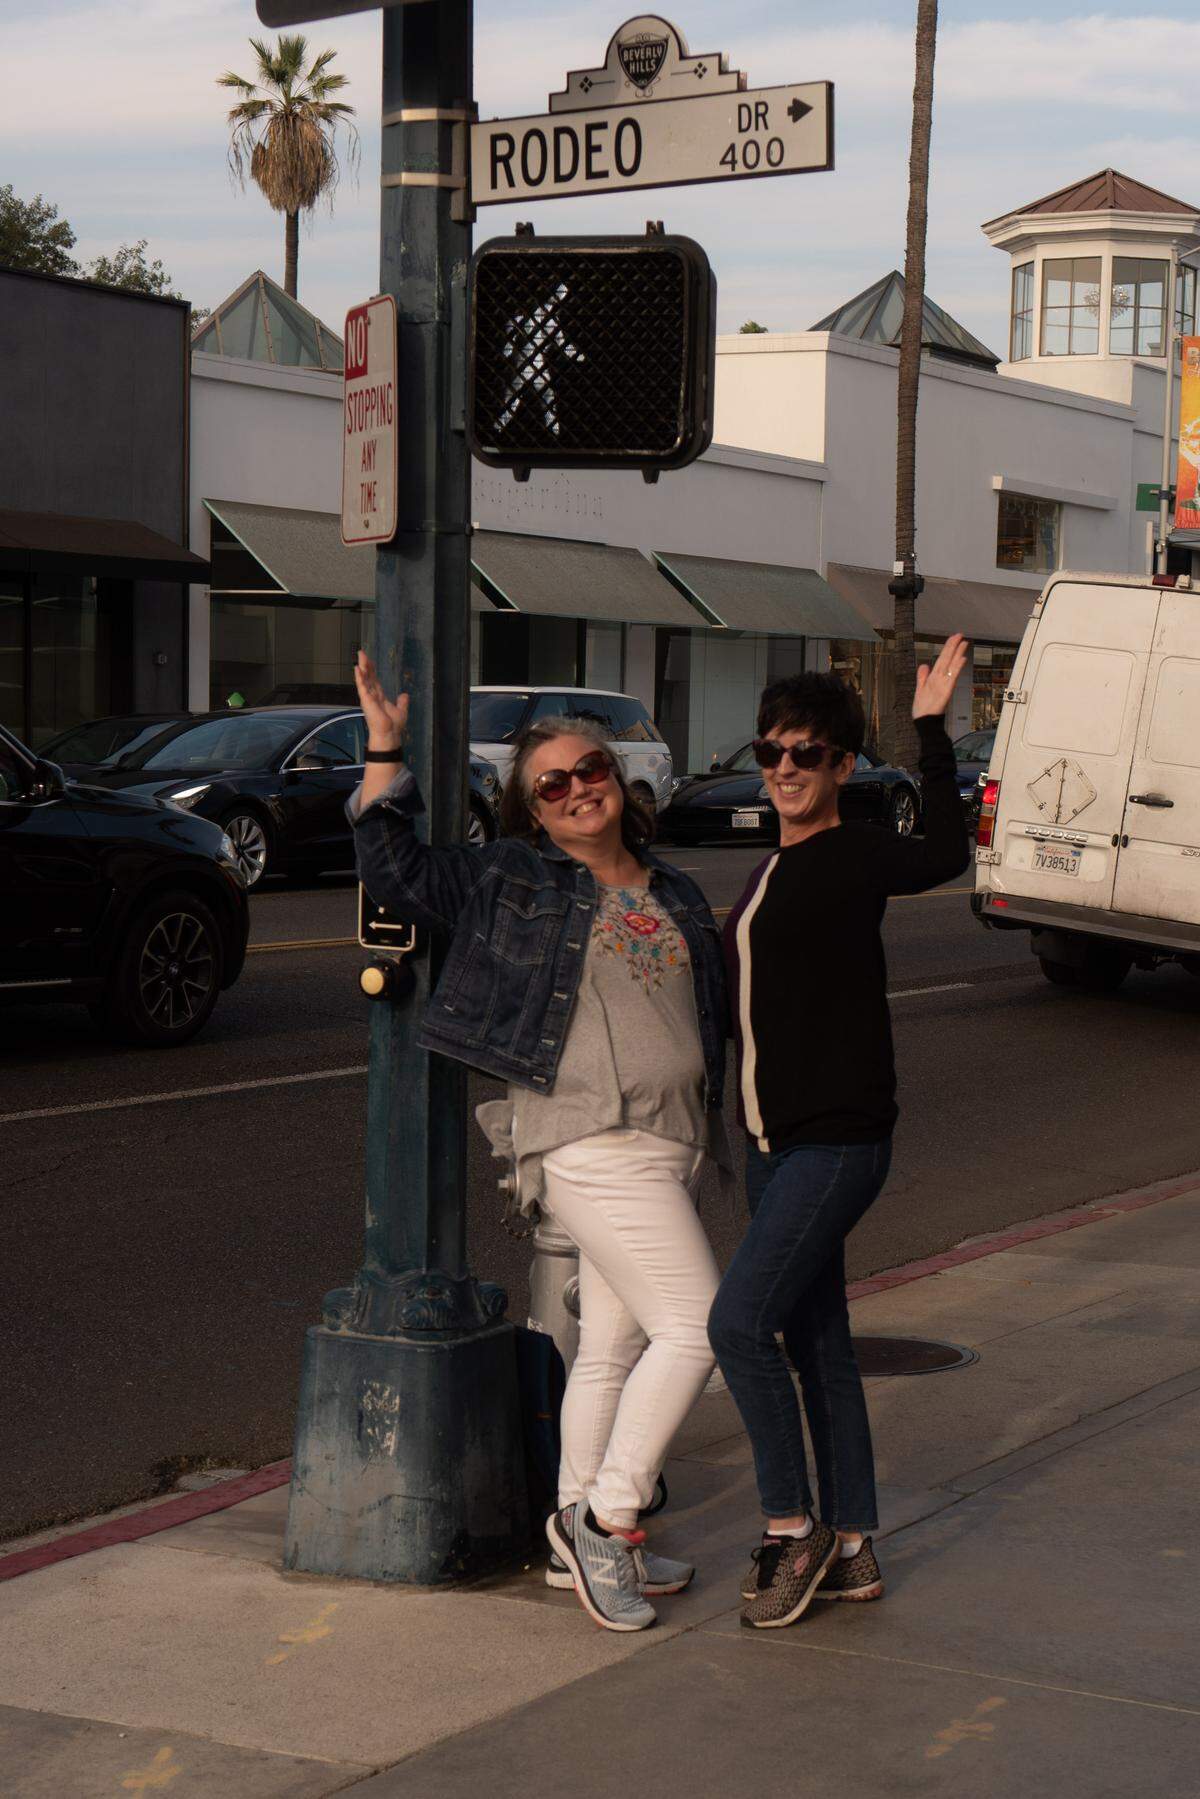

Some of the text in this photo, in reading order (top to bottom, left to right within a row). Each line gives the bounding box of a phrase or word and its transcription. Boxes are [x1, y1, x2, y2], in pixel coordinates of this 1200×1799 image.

[623, 45, 663, 61] BEVERLY
[629, 59, 656, 74] HILLS
[490, 101, 769, 190] RODEO DR
[719, 137, 785, 172] 400
[347, 316, 366, 369] NO
[347, 382, 393, 434] STOPPING
[361, 439, 377, 473] ANY
[360, 481, 377, 514] TIME
[1035, 853, 1077, 872] 7V38513
